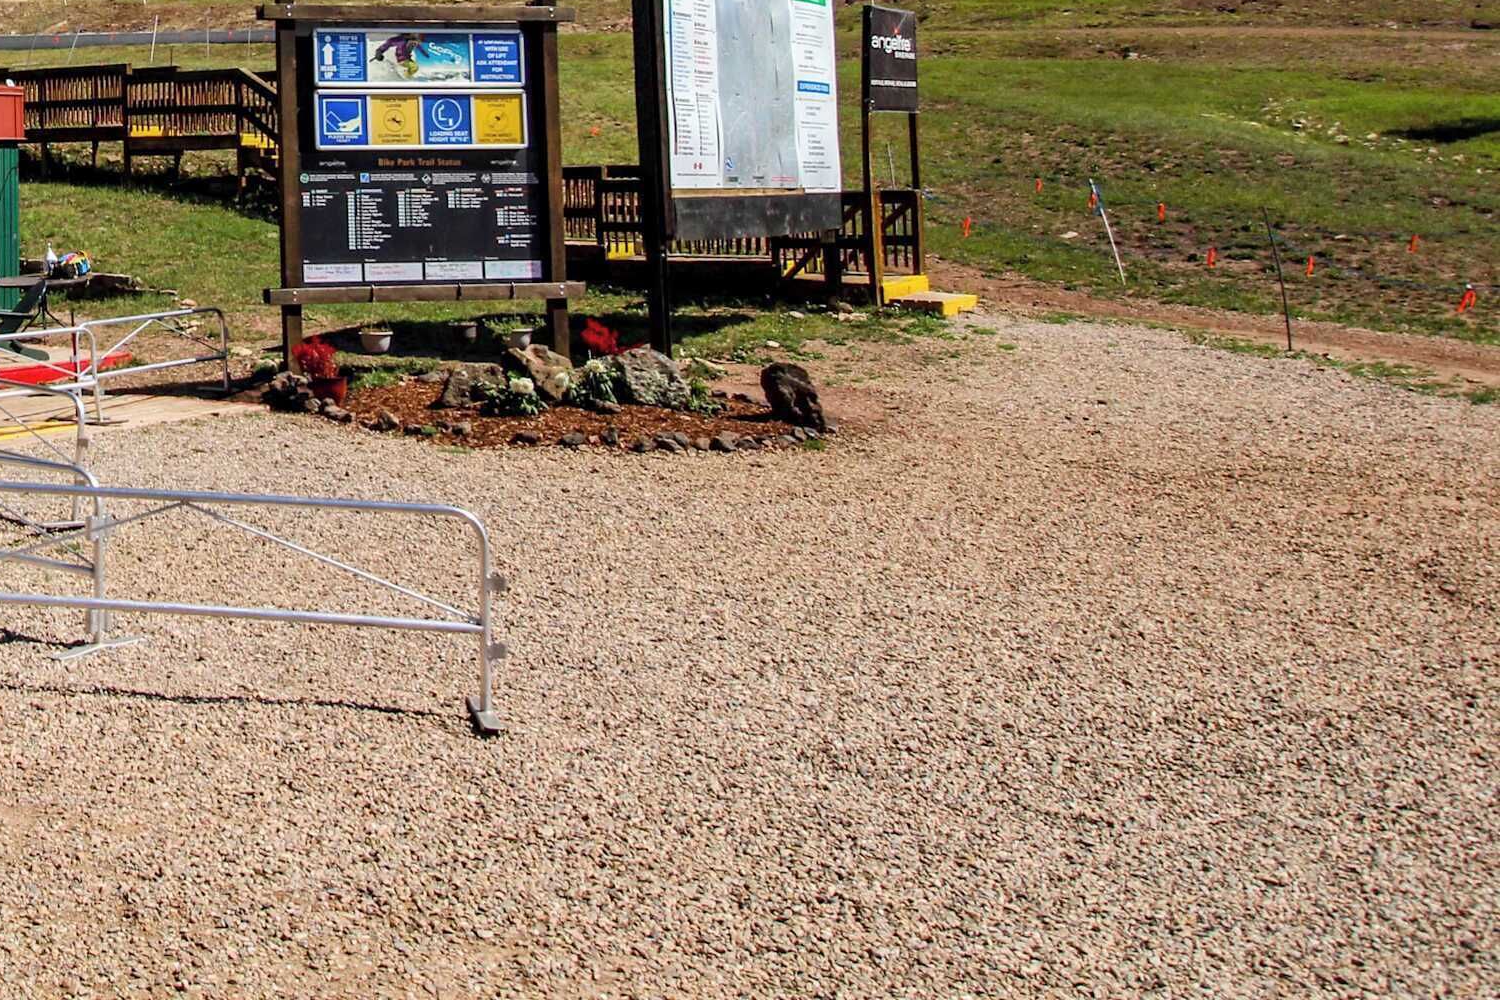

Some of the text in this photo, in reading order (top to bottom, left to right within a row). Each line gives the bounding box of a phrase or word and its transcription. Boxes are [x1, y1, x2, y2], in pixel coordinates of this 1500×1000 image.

[378, 157, 462, 167] Bike Park Trail Status
